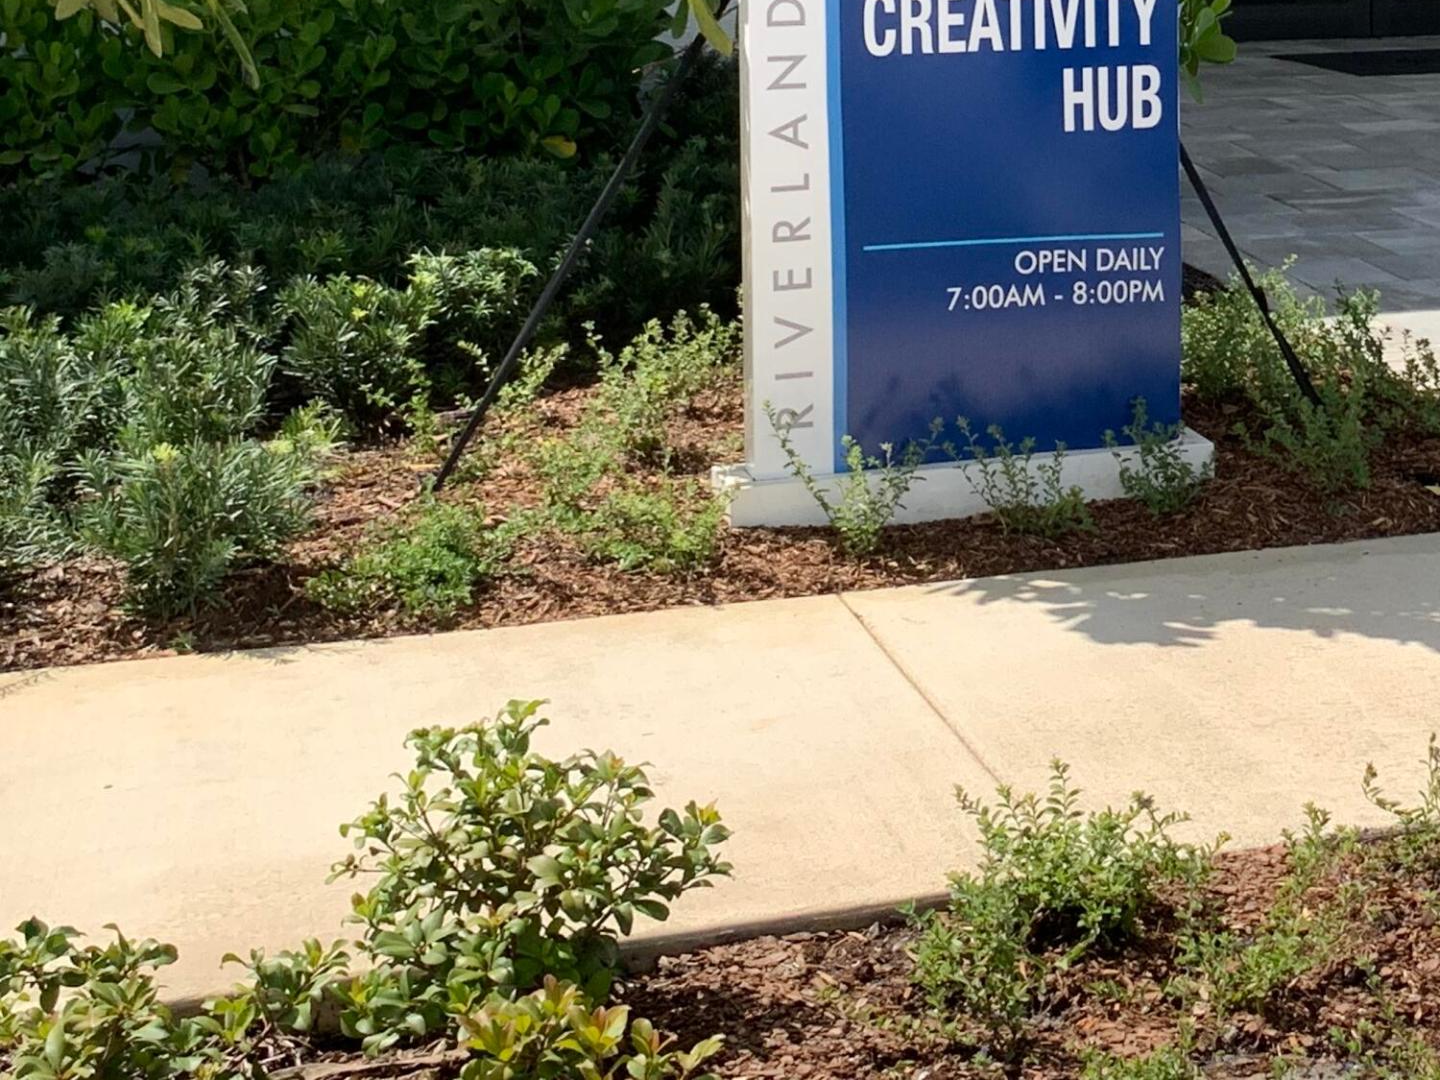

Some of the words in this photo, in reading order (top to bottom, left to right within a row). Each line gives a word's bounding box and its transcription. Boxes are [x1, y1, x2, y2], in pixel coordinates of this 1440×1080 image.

[1062, 64, 1162, 132] HUB
[1014, 249, 1086, 274] OPEN
[1096, 247, 1164, 271] DAILY
[946, 283, 1045, 311] 7:00AM
[1072, 279, 1164, 304] 8:00PM
